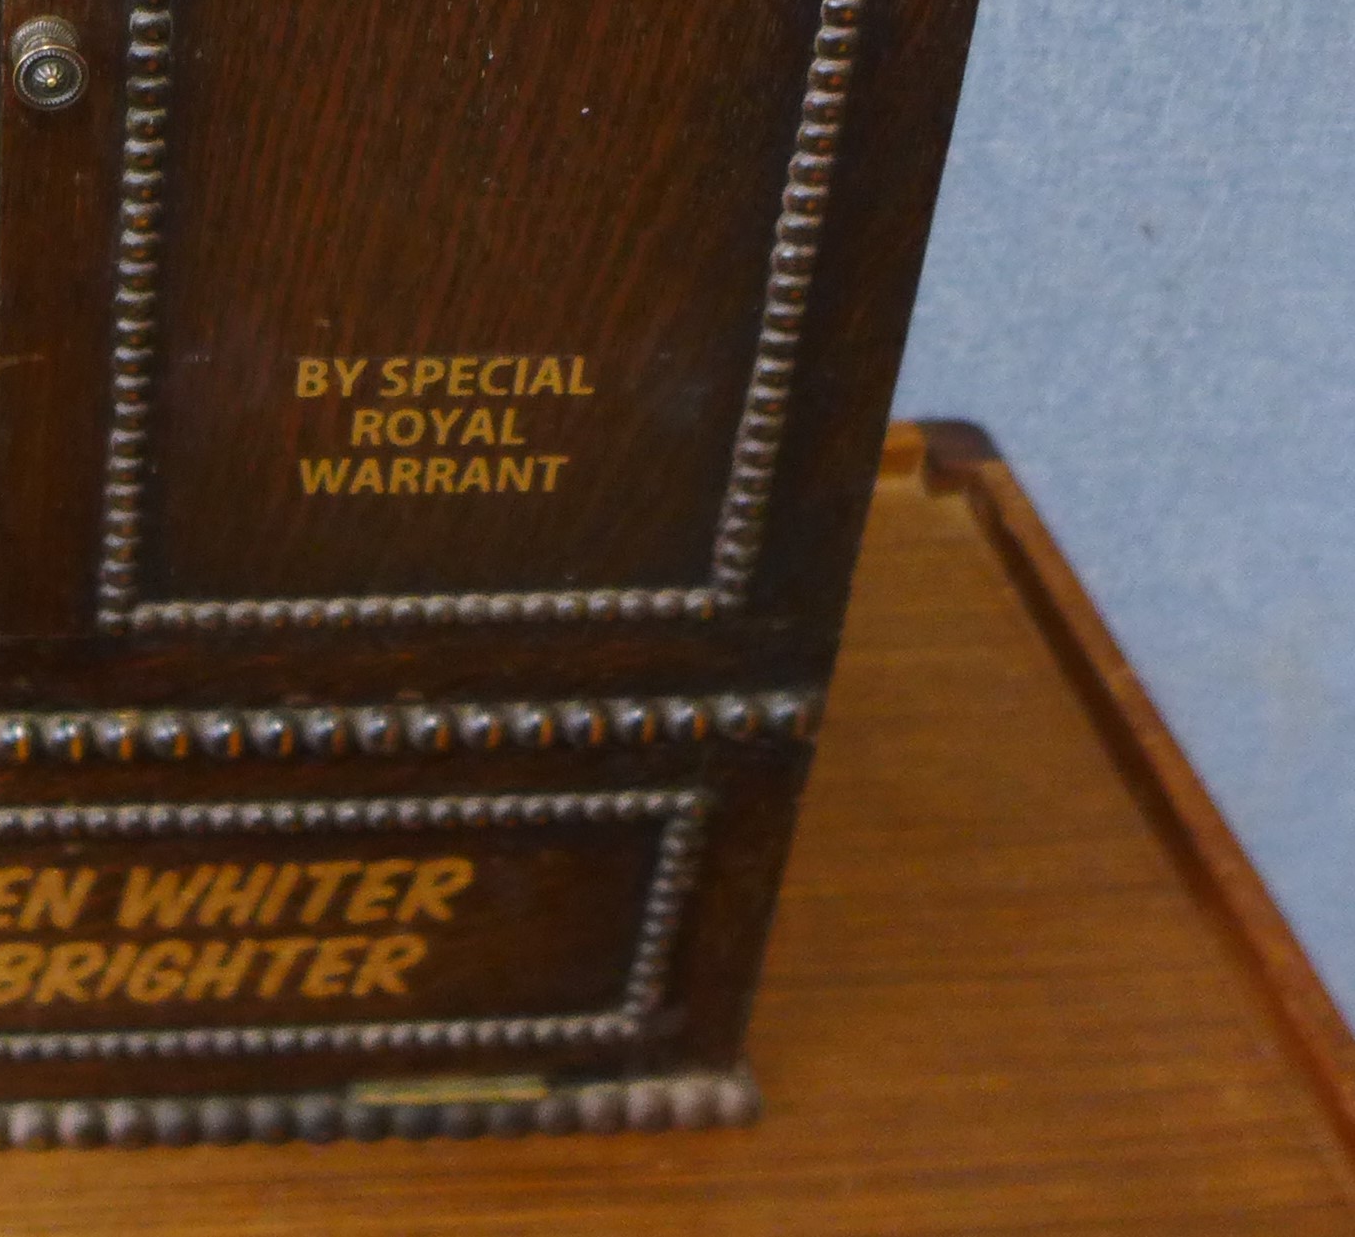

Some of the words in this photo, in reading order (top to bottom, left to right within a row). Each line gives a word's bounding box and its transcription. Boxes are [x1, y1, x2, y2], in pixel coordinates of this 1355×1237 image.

[295, 357, 368, 399] BY
[380, 355, 595, 398] SPECIAL
[350, 407, 526, 447] ROYAL
[299, 455, 570, 496] WARRANT
[117, 858, 473, 929] WHITER
